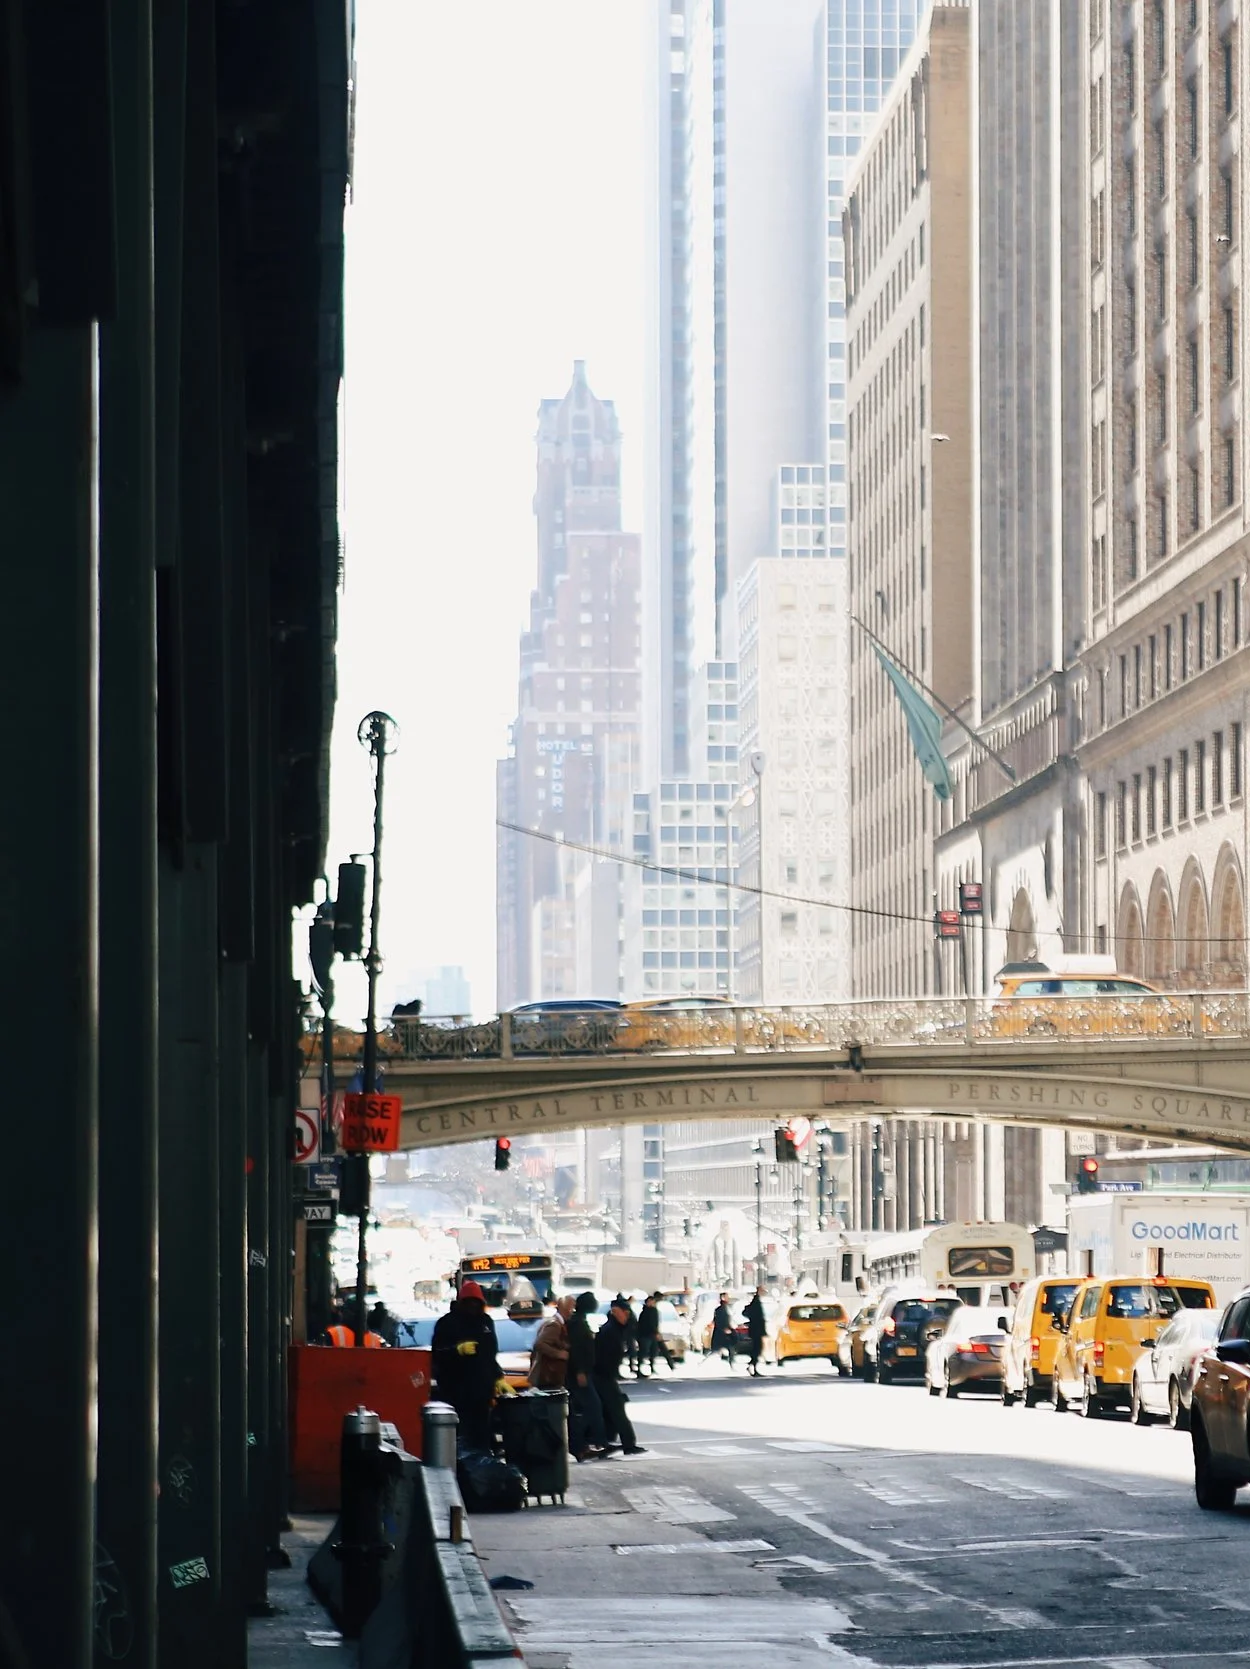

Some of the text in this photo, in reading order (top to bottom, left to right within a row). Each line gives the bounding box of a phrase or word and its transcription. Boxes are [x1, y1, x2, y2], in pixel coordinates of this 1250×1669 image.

[537, 740, 578, 750] HOTEL
[949, 1082, 1109, 1109] PERSHING
[416, 1086, 760, 1133] CENTRAL TERMINAL
[1101, 1184, 1135, 1192] Park Ave
[1131, 1221, 1240, 1241] GoodMart
[1174, 1251, 1204, 1259] Electrical
[1206, 1251, 1242, 1259] Distributor
